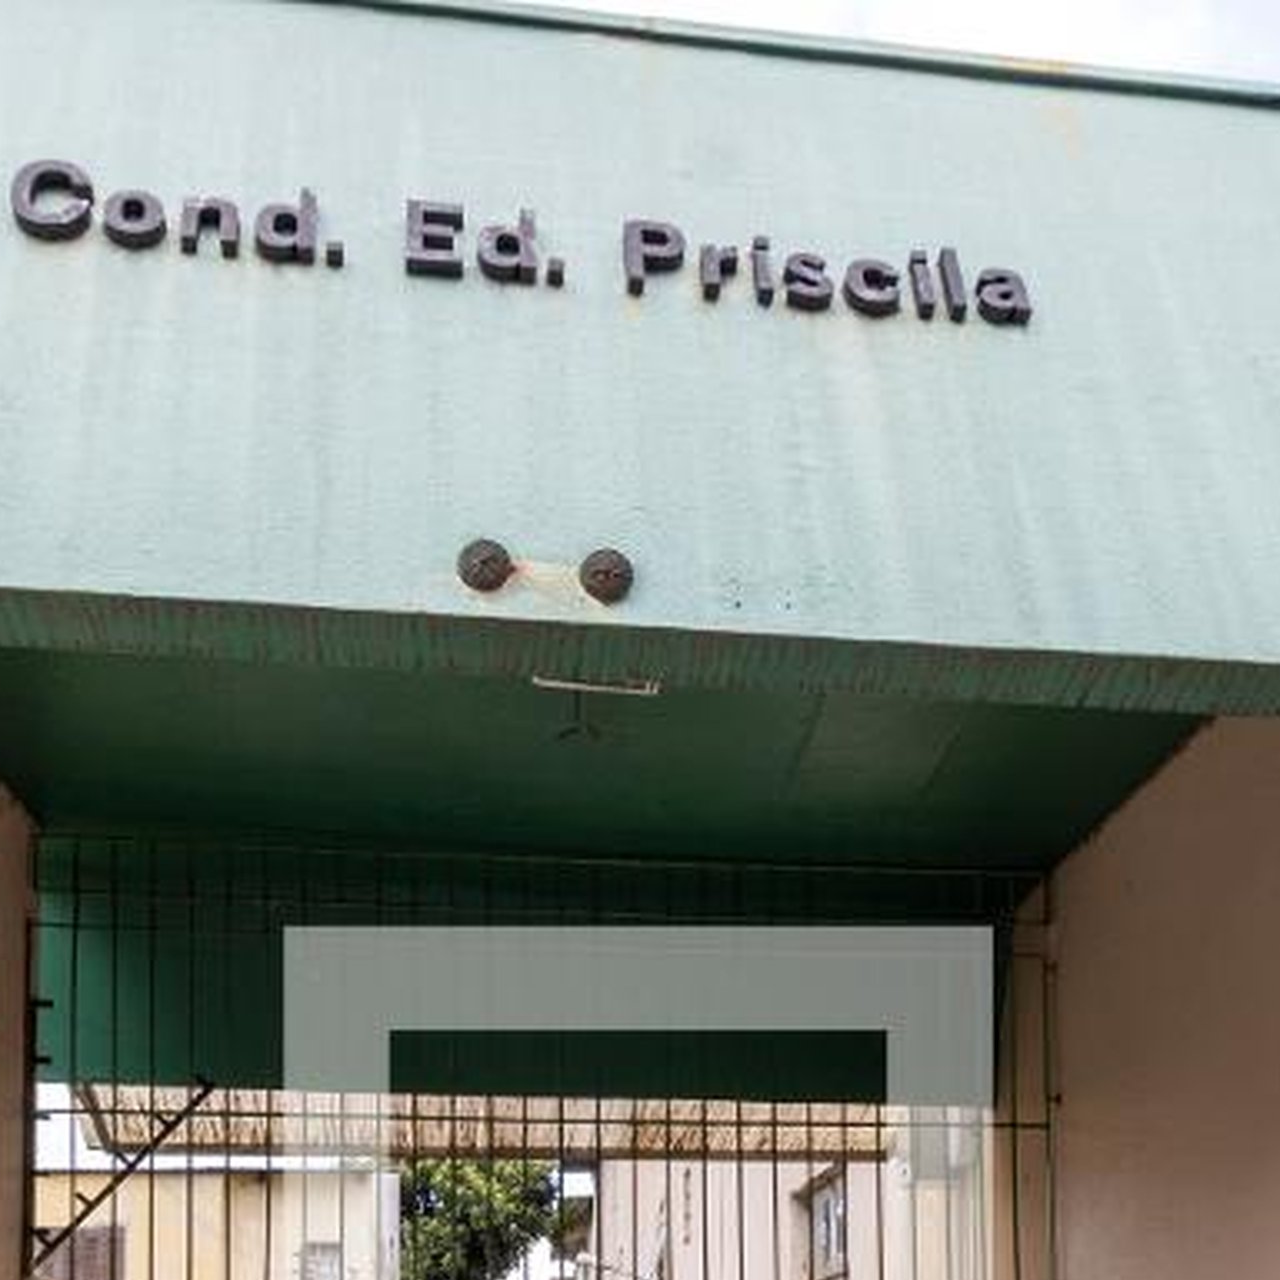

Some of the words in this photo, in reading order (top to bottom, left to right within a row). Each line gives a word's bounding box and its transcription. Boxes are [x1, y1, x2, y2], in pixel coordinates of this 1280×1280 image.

[10, 160, 345, 273] Cond.
[404, 200, 566, 292] Ed.
[622, 220, 1034, 333] Priscila
